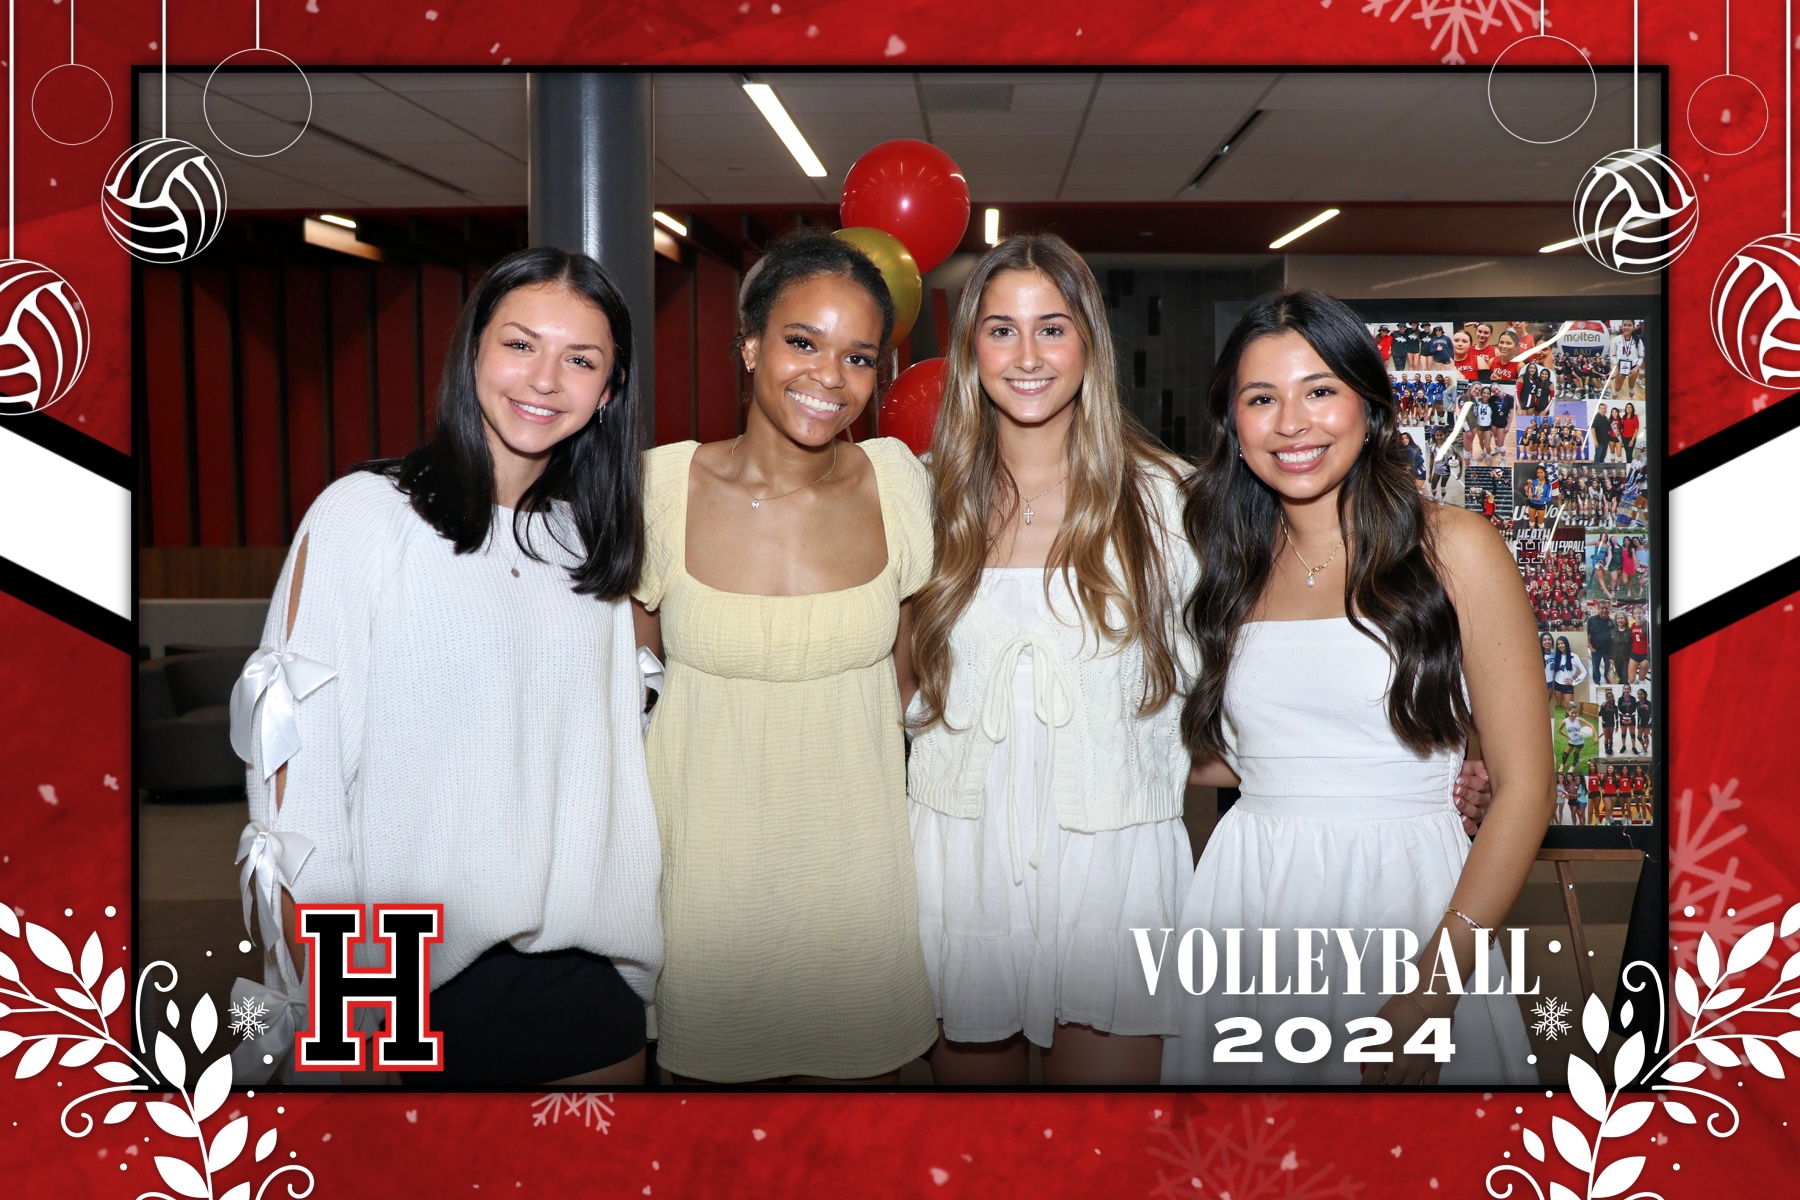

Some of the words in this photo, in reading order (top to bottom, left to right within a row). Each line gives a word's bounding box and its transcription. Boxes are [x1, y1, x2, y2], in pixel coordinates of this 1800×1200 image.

[1564, 332, 1600, 342] molten
[1517, 528, 1551, 540] HEATH
[1541, 540, 1585, 553] VLLEYBALL
